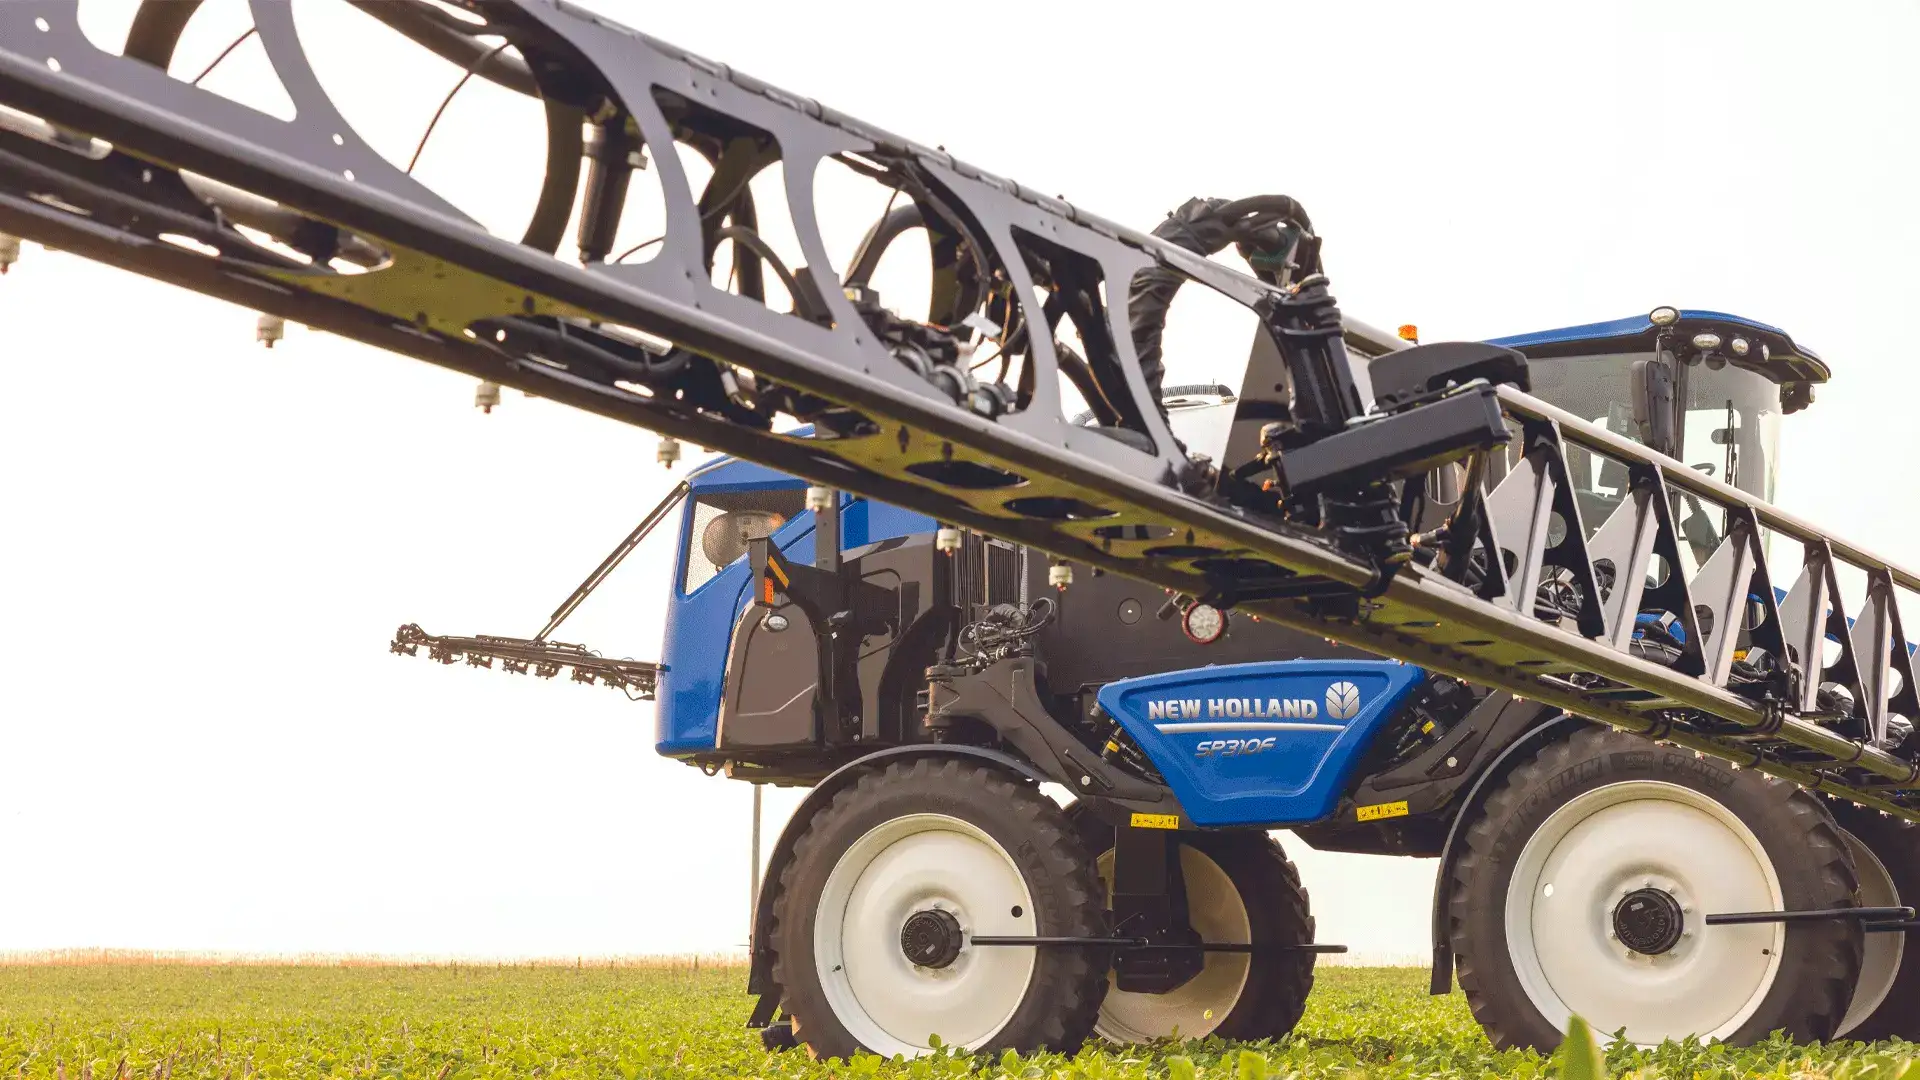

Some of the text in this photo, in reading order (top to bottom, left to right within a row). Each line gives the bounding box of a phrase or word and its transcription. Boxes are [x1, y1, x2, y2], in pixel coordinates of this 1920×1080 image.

[1148, 698, 1318, 720] NEW HOLLAND
[1195, 737, 1277, 758] SP310F
